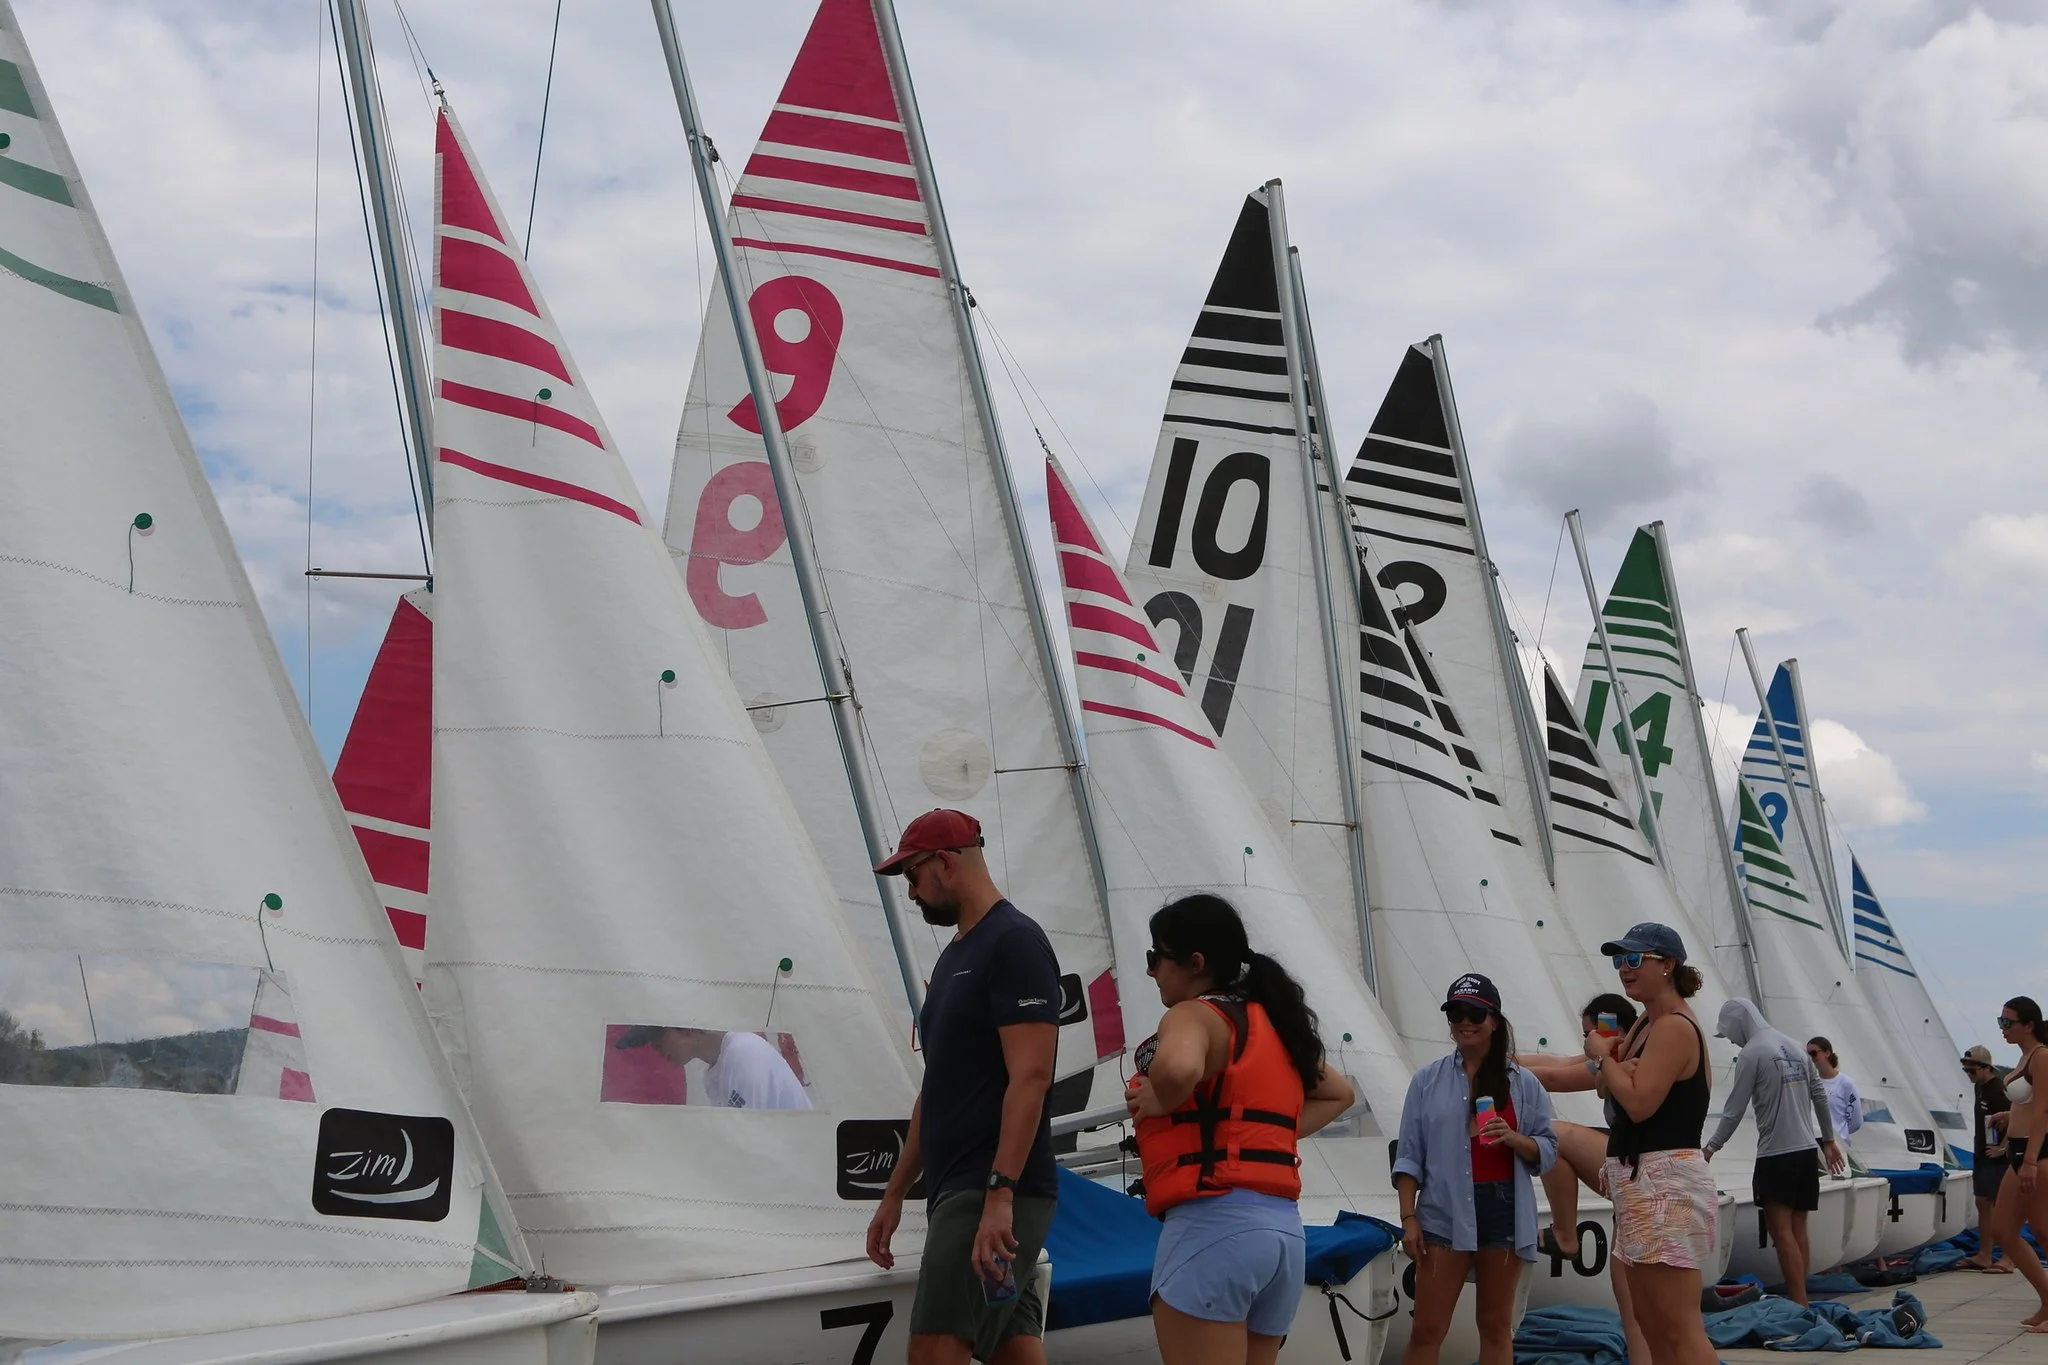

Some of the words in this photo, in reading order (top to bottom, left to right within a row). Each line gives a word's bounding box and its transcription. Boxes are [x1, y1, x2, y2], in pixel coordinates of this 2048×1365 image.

[726, 275, 844, 434] 9
[1148, 437, 1271, 581] 10
[1584, 680, 1673, 778] 14
[820, 1300, 894, 1365] 7
